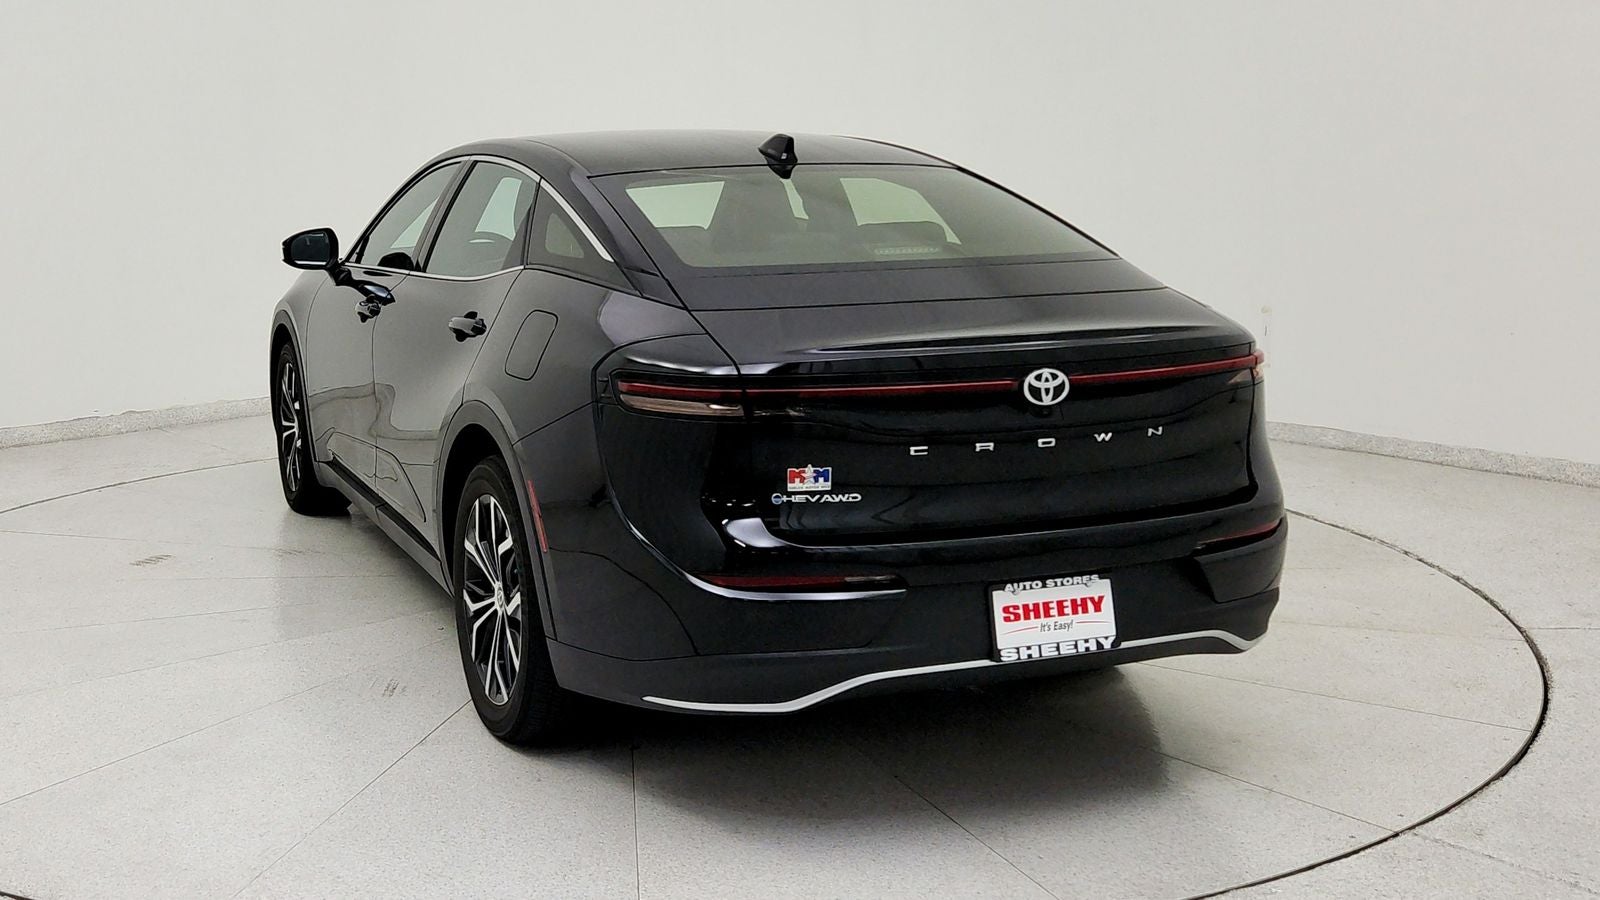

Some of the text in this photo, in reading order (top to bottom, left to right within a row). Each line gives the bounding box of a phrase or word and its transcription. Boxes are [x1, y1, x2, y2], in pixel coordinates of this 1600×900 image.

[910, 426, 1163, 455] CROWN
[1004, 574, 1100, 593] AUTO STORES
[1002, 595, 1105, 623] SHEEHY
[1040, 619, 1074, 633] It's Easy!
[1000, 636, 1116, 662] SHEEHY
